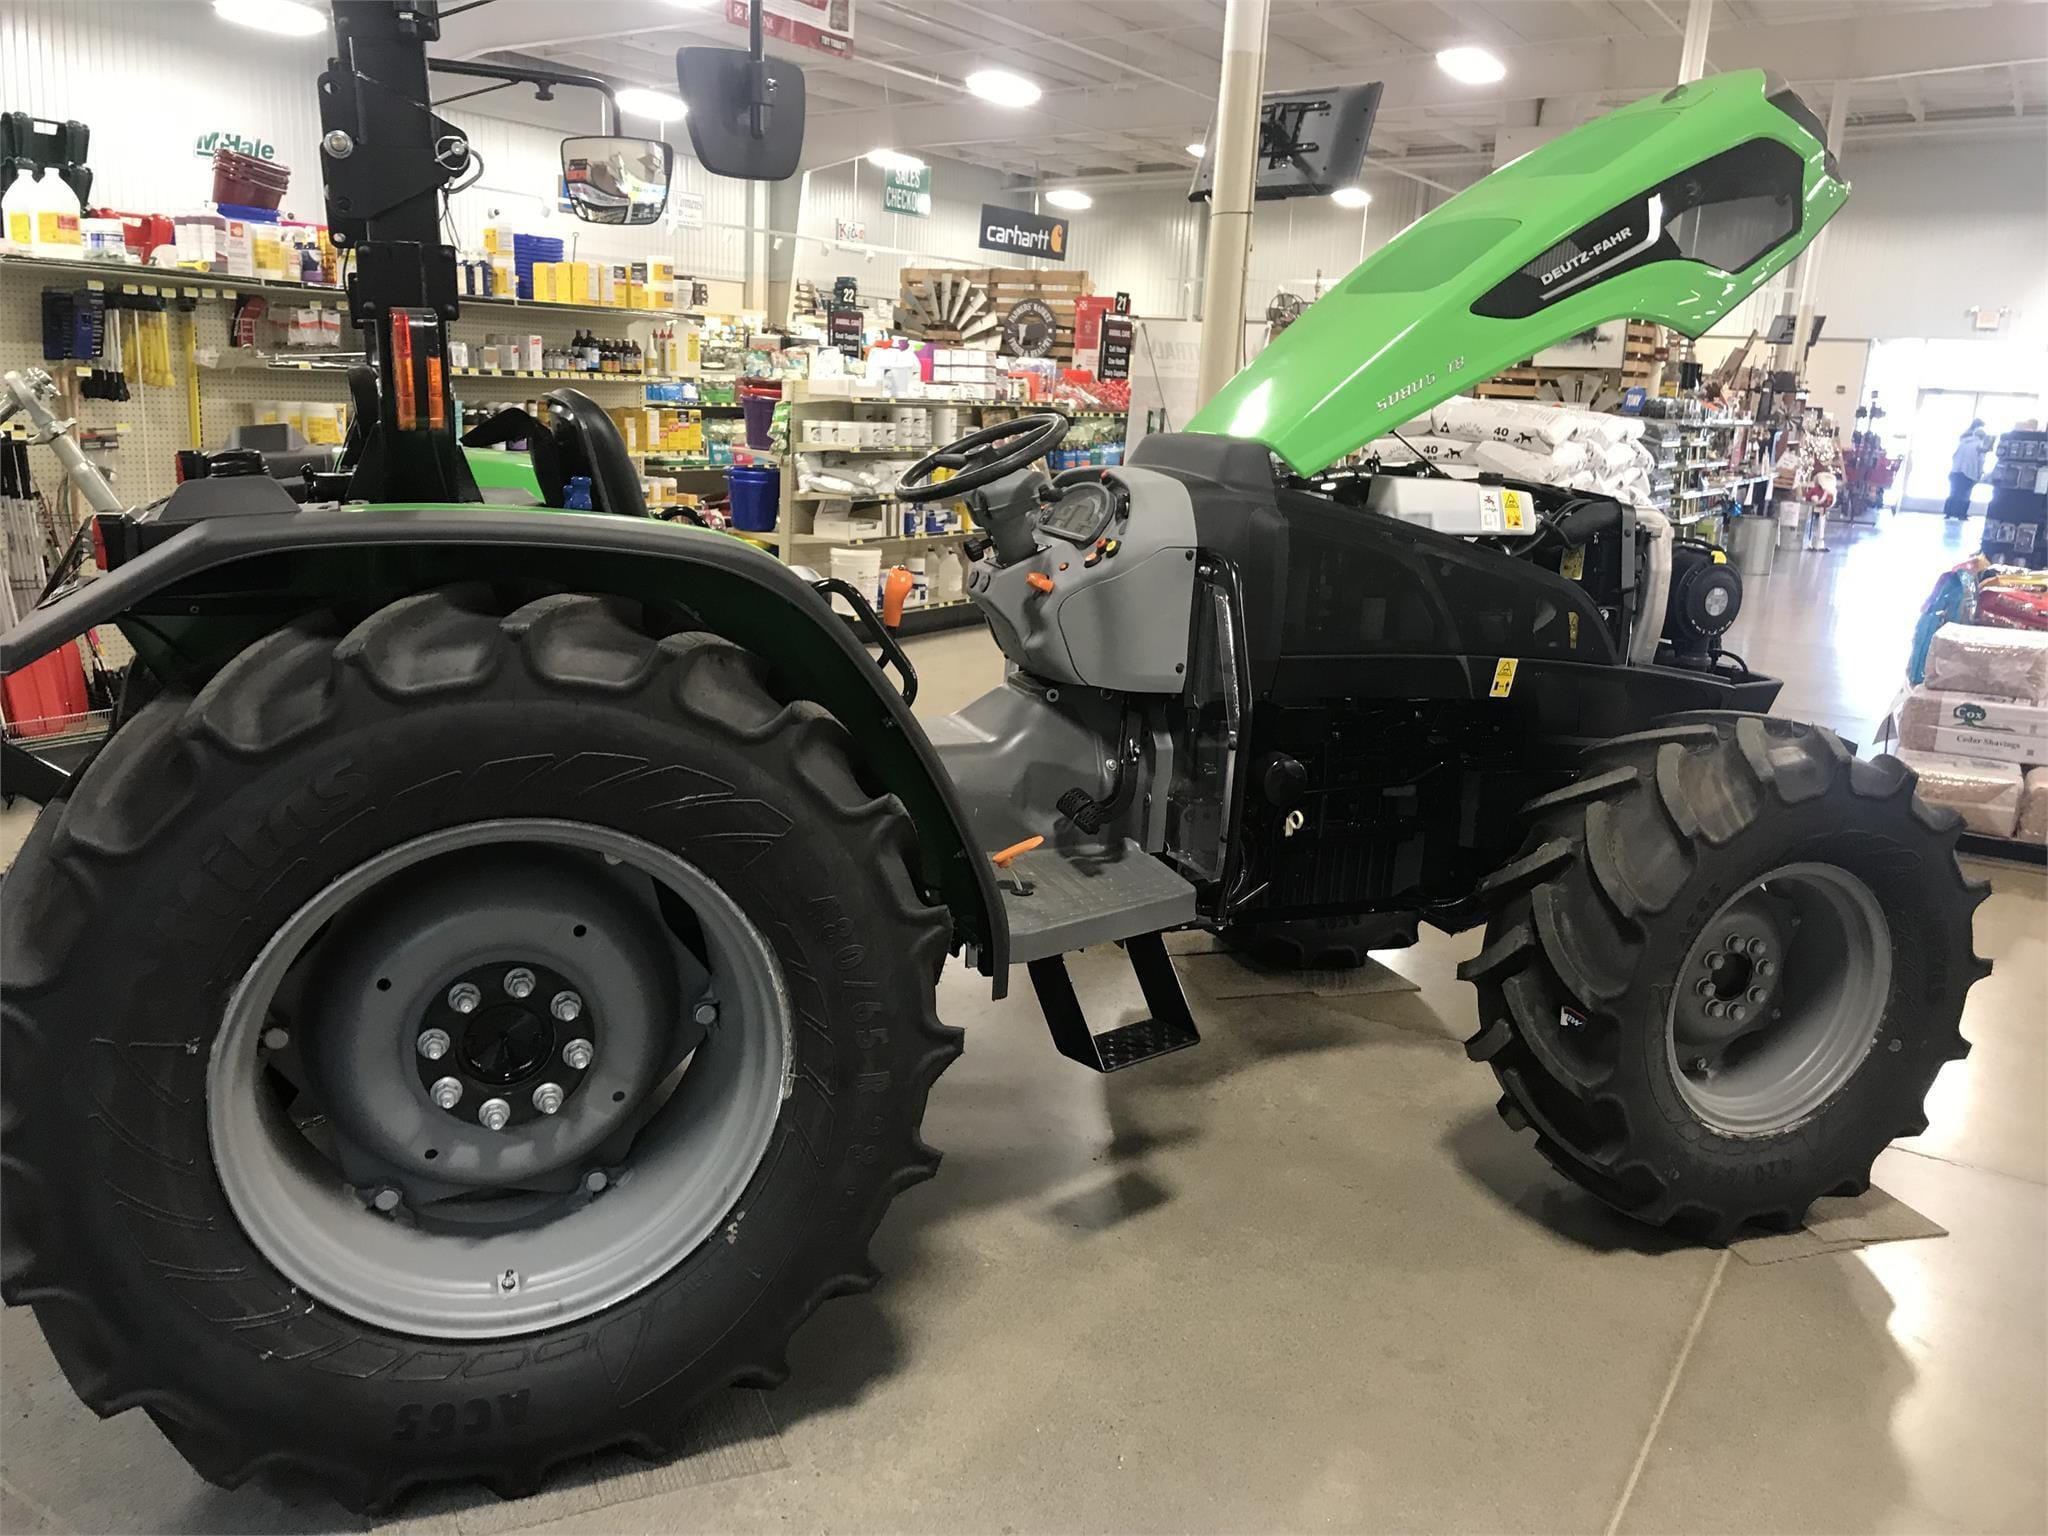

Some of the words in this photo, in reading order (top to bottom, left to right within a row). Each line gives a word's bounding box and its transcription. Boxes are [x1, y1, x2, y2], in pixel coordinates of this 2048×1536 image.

[895, 166, 920, 189] SALES
[986, 224, 1050, 251] carhartt
[1540, 226, 1633, 286] DEUTZ-FAHR
[843, 288, 855, 303] 22
[1117, 295, 1127, 311] 21
[1493, 427, 1509, 437] 40
[1424, 445, 1438, 454] 40
[1956, 706, 1983, 720] Cox
[1956, 734, 1981, 745] Cedar
[1983, 738, 2021, 750] Shavings
[391, 1387, 532, 1442] AC65
